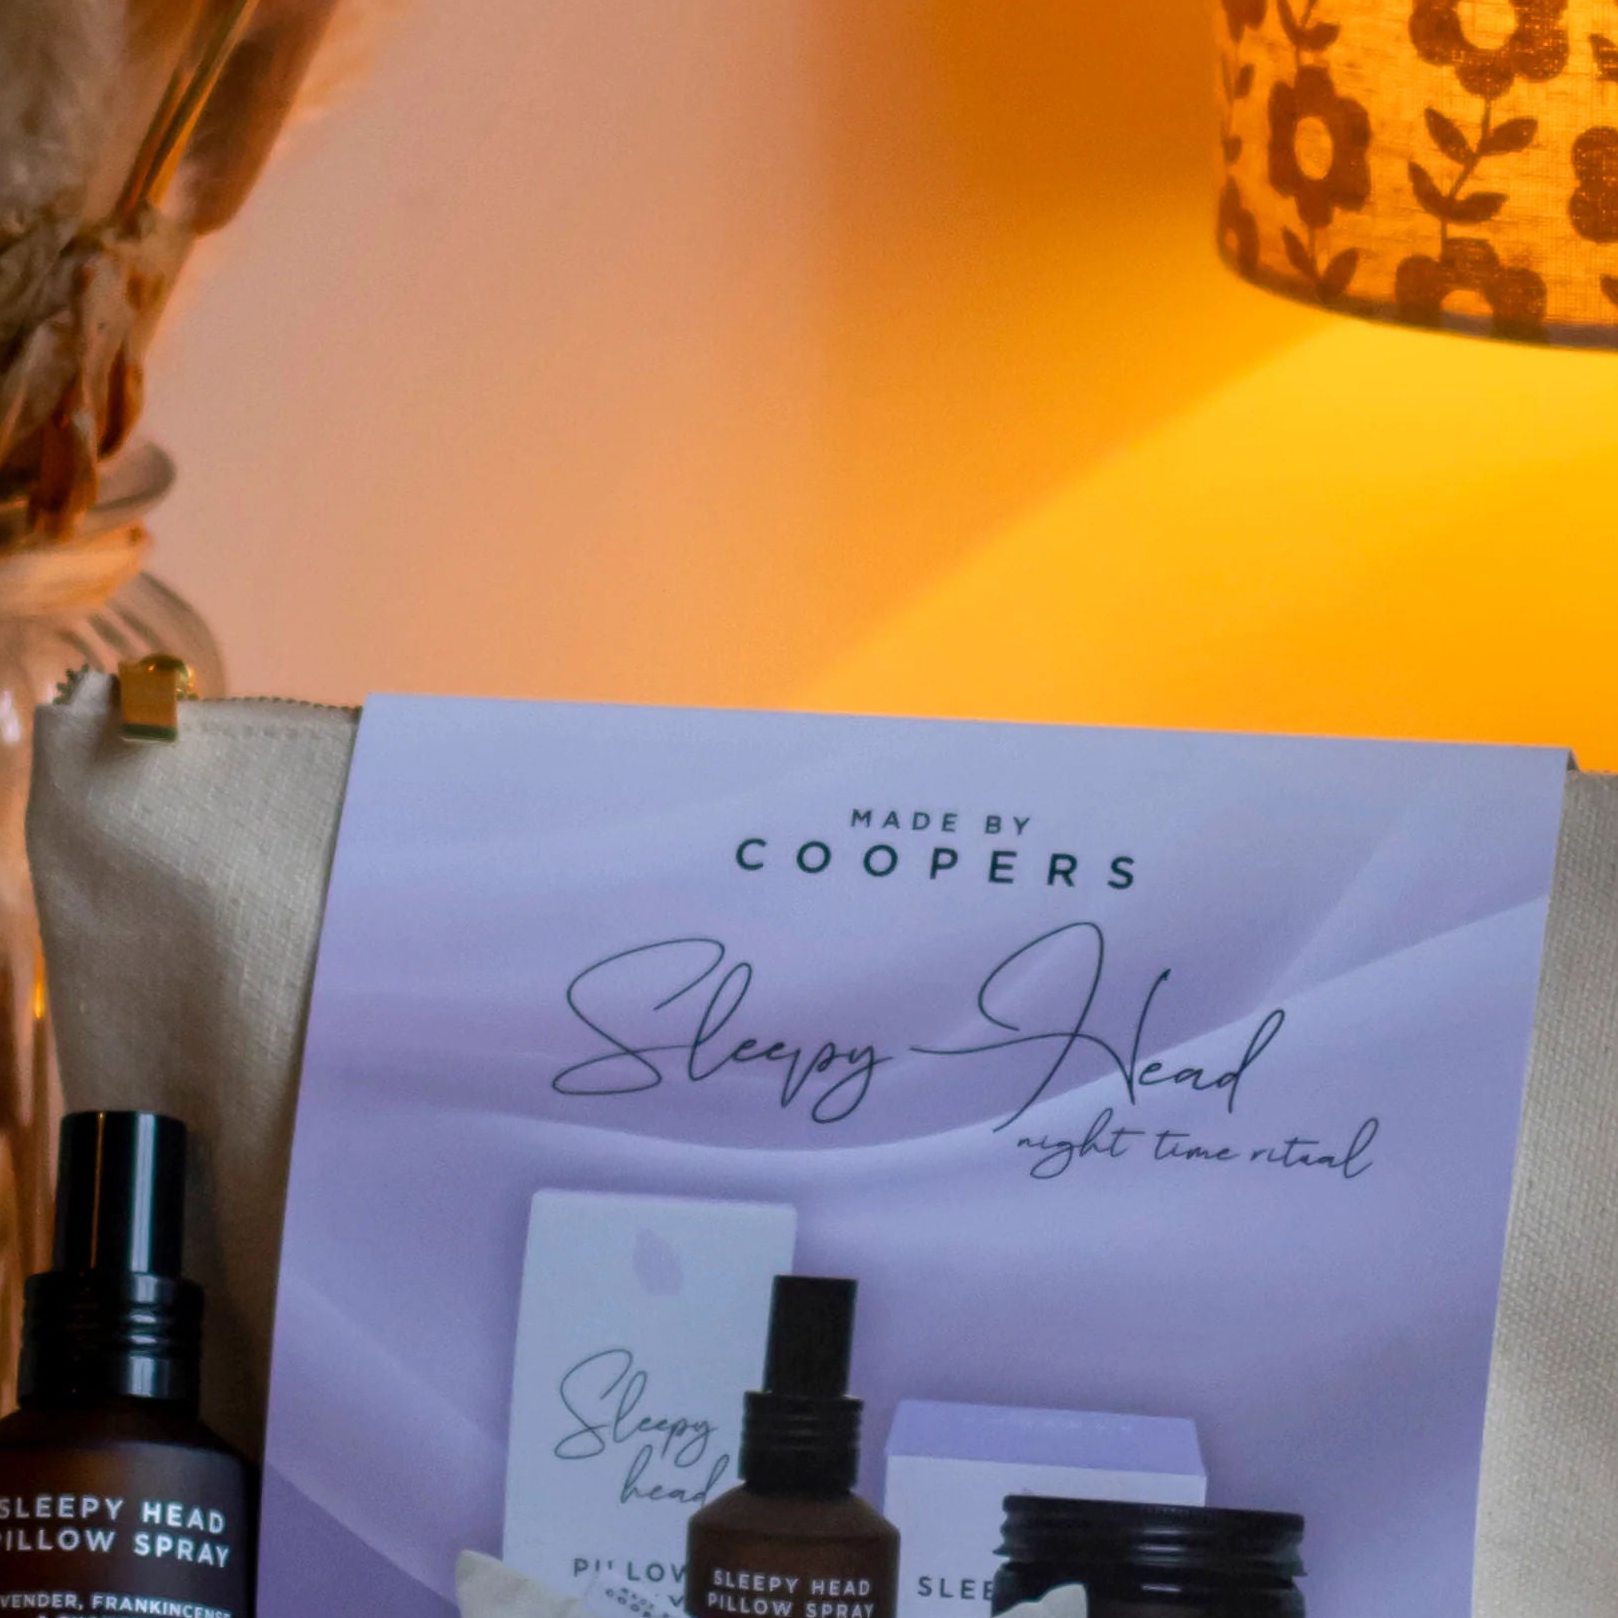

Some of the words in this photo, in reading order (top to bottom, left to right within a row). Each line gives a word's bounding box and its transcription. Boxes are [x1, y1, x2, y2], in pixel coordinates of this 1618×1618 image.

[850, 808, 959, 832] MADE
[984, 815, 1030, 836] BY
[735, 838, 1135, 890] COOPERS
[551, 936, 895, 1123] Sleepy
[910, 920, 1286, 1133] Head
[1016, 1107, 1146, 1180] night
[1153, 1129, 1237, 1161] time
[1249, 1117, 1379, 1179] ritual
[553, 1348, 719, 1468] Sleepy
[619, 1443, 730, 1508] head
[141, 1500, 225, 1534] HEAD
[133, 1533, 230, 1569] SPRAY
[712, 1569, 799, 1595] SLEEPY
[810, 1579, 871, 1596] HEAD
[917, 1576, 994, 1600] SLEE
[707, 1592, 793, 1618] PILLOW
